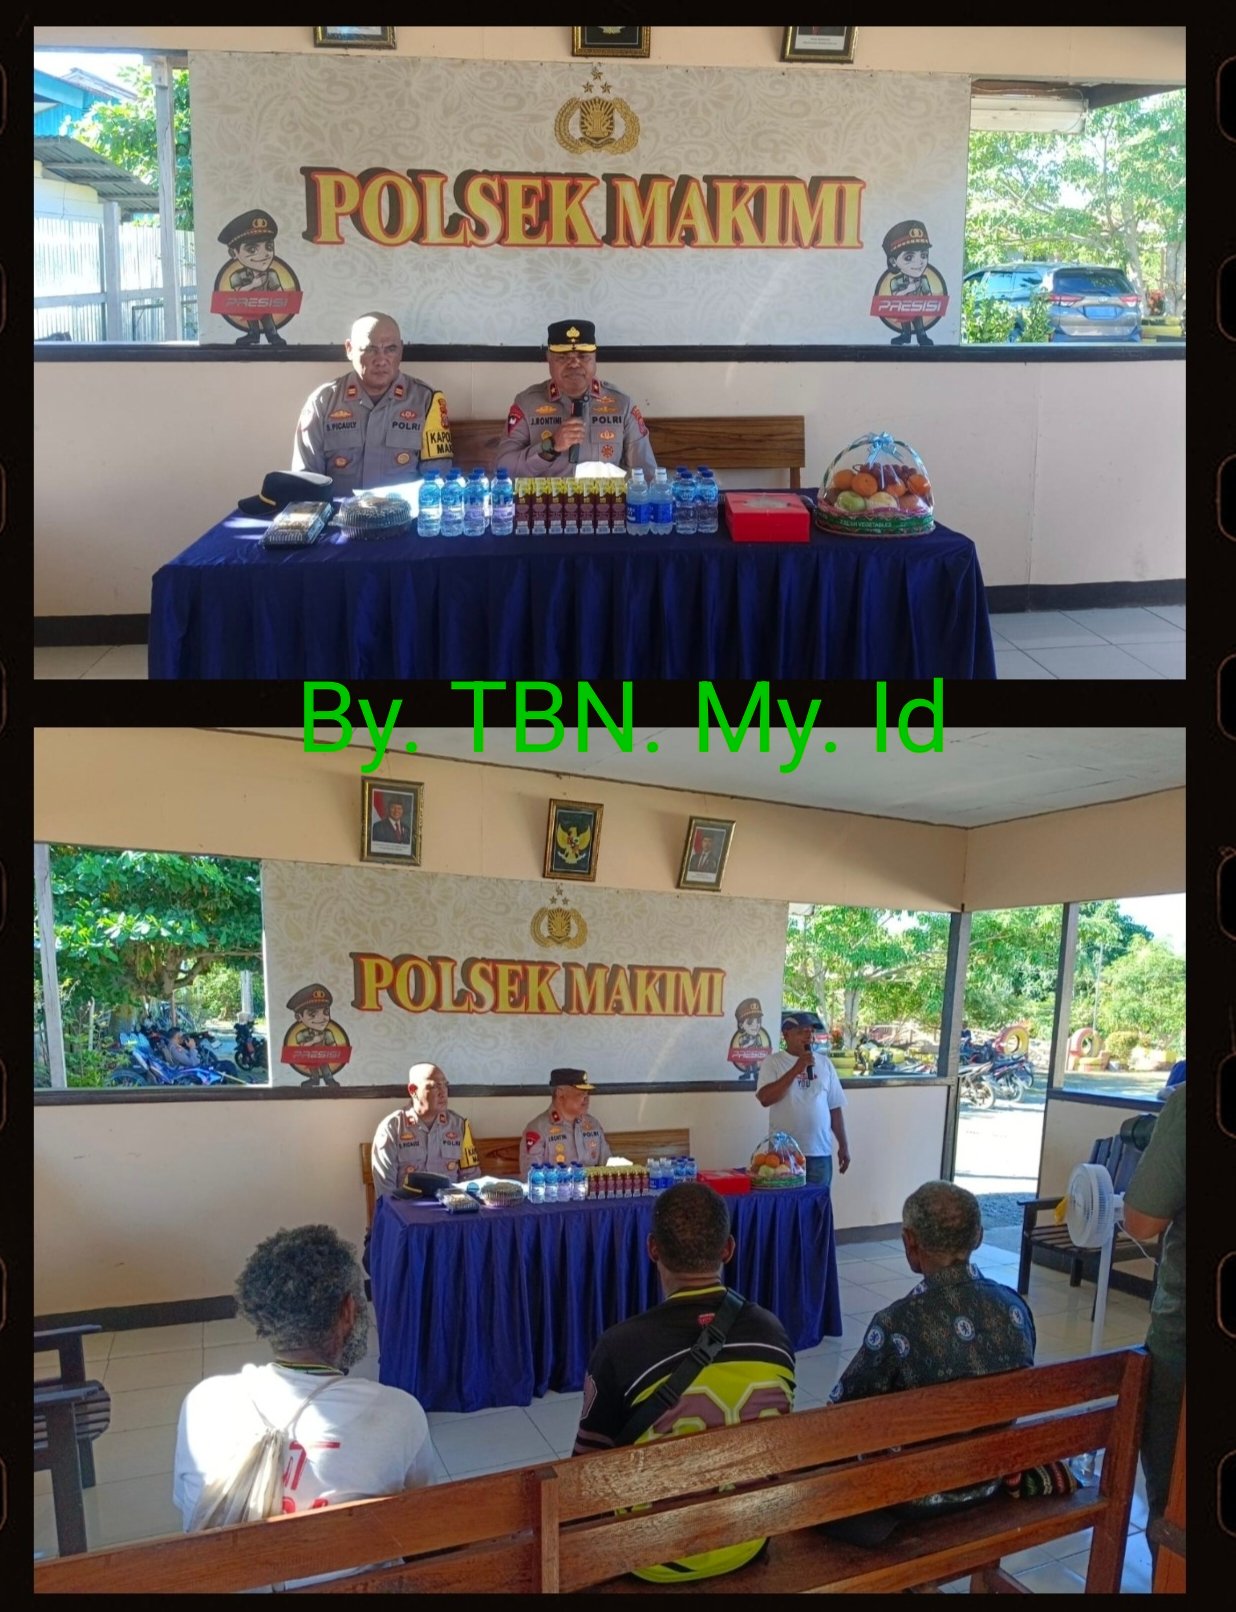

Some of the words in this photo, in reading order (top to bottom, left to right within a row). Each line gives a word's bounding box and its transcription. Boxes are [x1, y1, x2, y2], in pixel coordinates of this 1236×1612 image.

[300, 166, 603, 247] POLSEK
[602, 173, 866, 249] MAKIMI
[225, 297, 288, 307] PRESISI
[879, 300, 942, 312] PRESISI
[592, 416, 622, 424] POLRI
[392, 421, 421, 431] POLRI
[350, 952, 562, 1014] POLSEK
[562, 962, 726, 1017] MAKIMI
